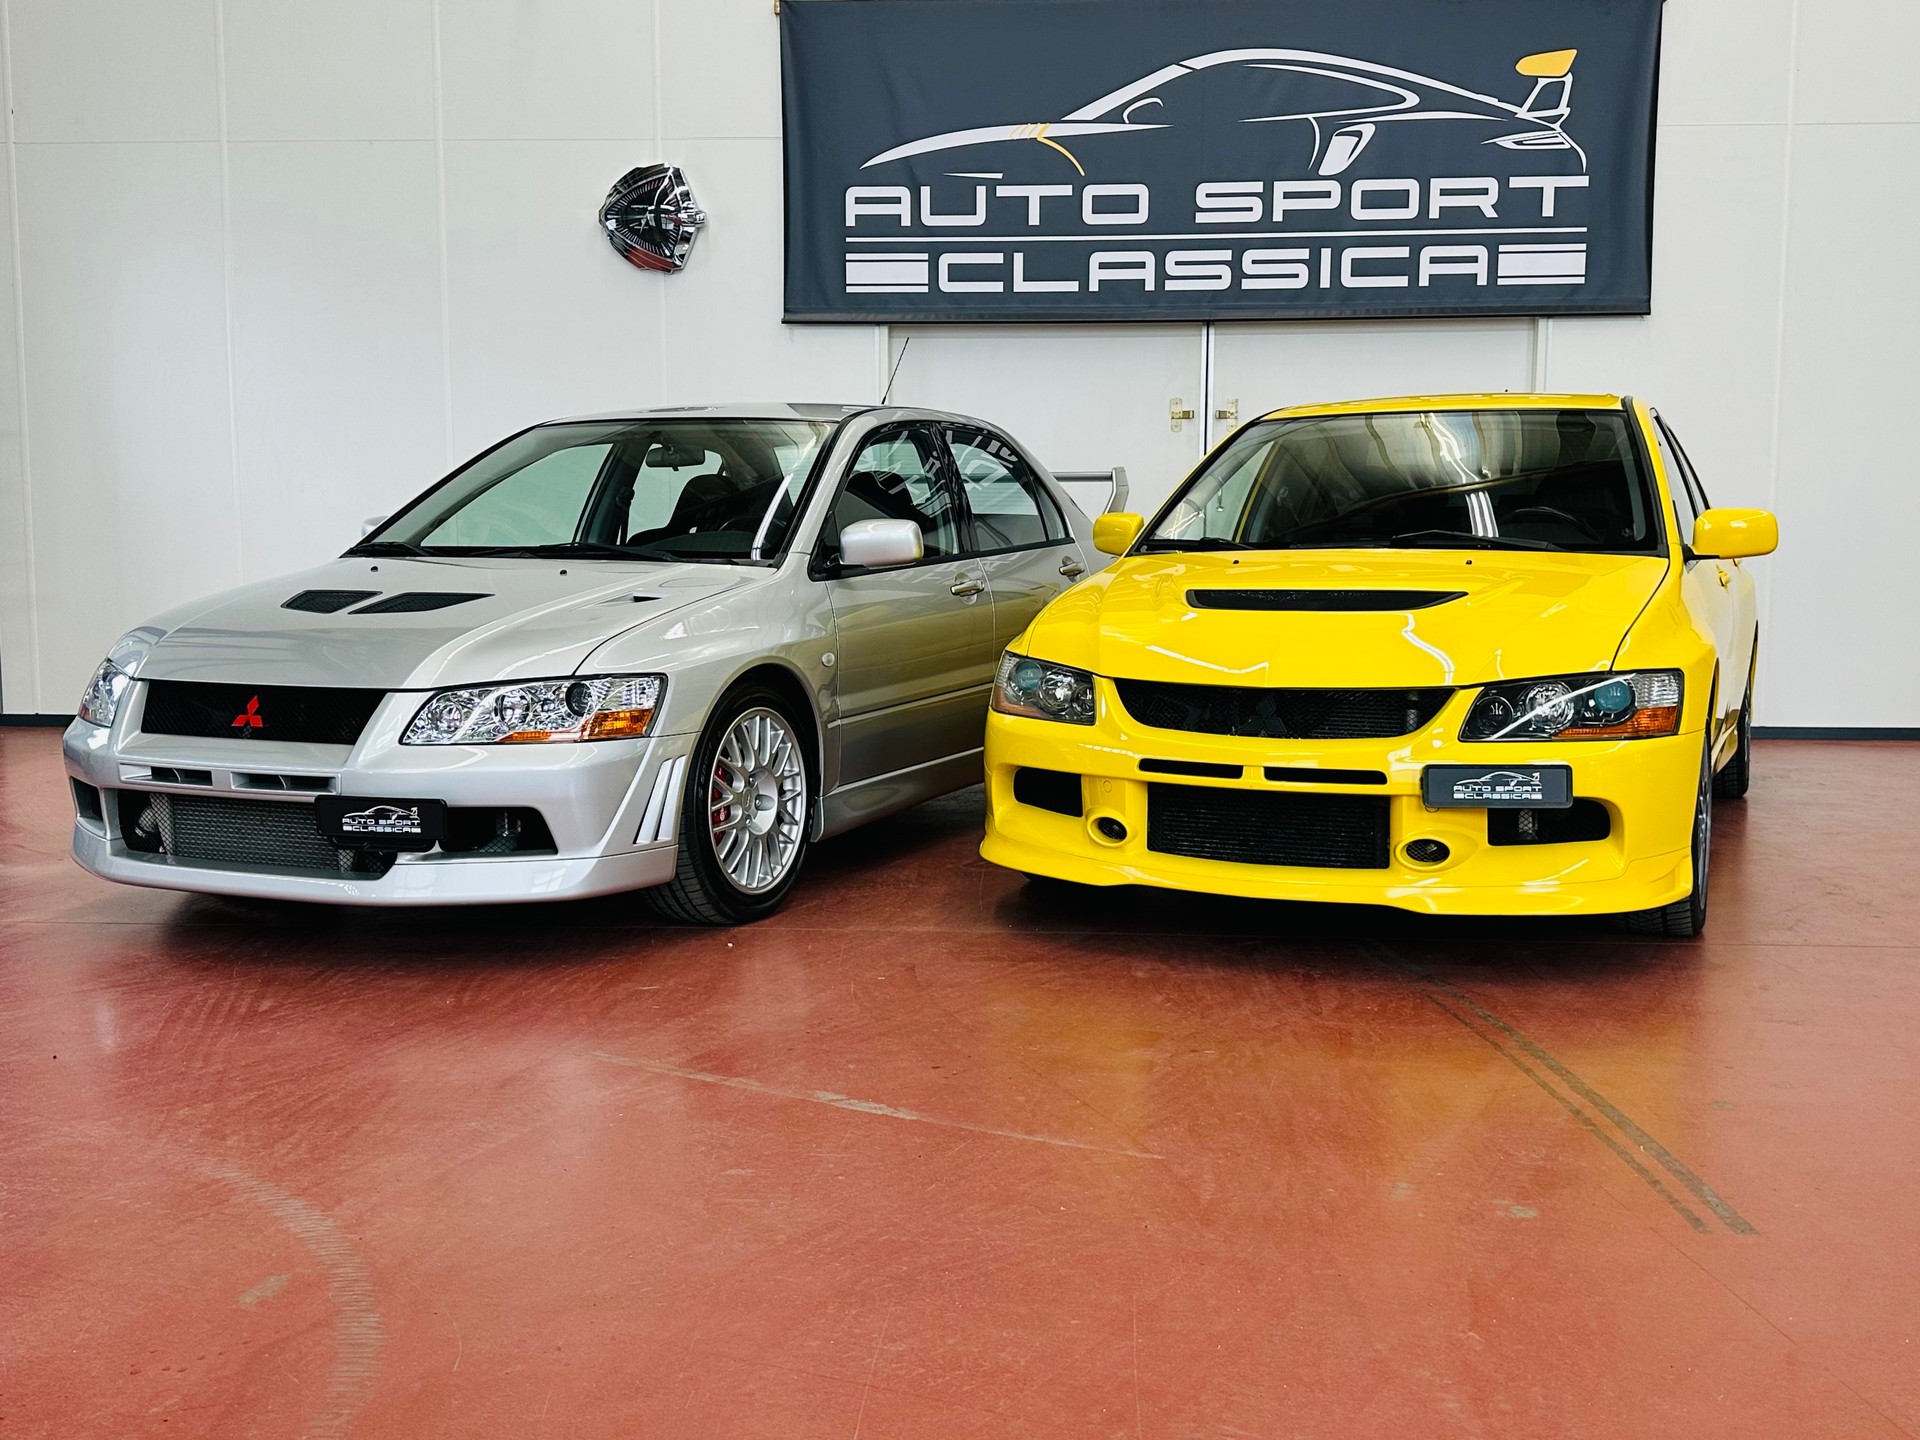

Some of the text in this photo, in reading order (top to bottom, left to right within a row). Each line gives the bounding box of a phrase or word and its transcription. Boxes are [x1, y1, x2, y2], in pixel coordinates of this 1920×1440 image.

[845, 176, 1590, 227] AUTO SPORT
[937, 244, 1490, 294] CLASSICA
[352, 825, 411, 833] CLASSICA
